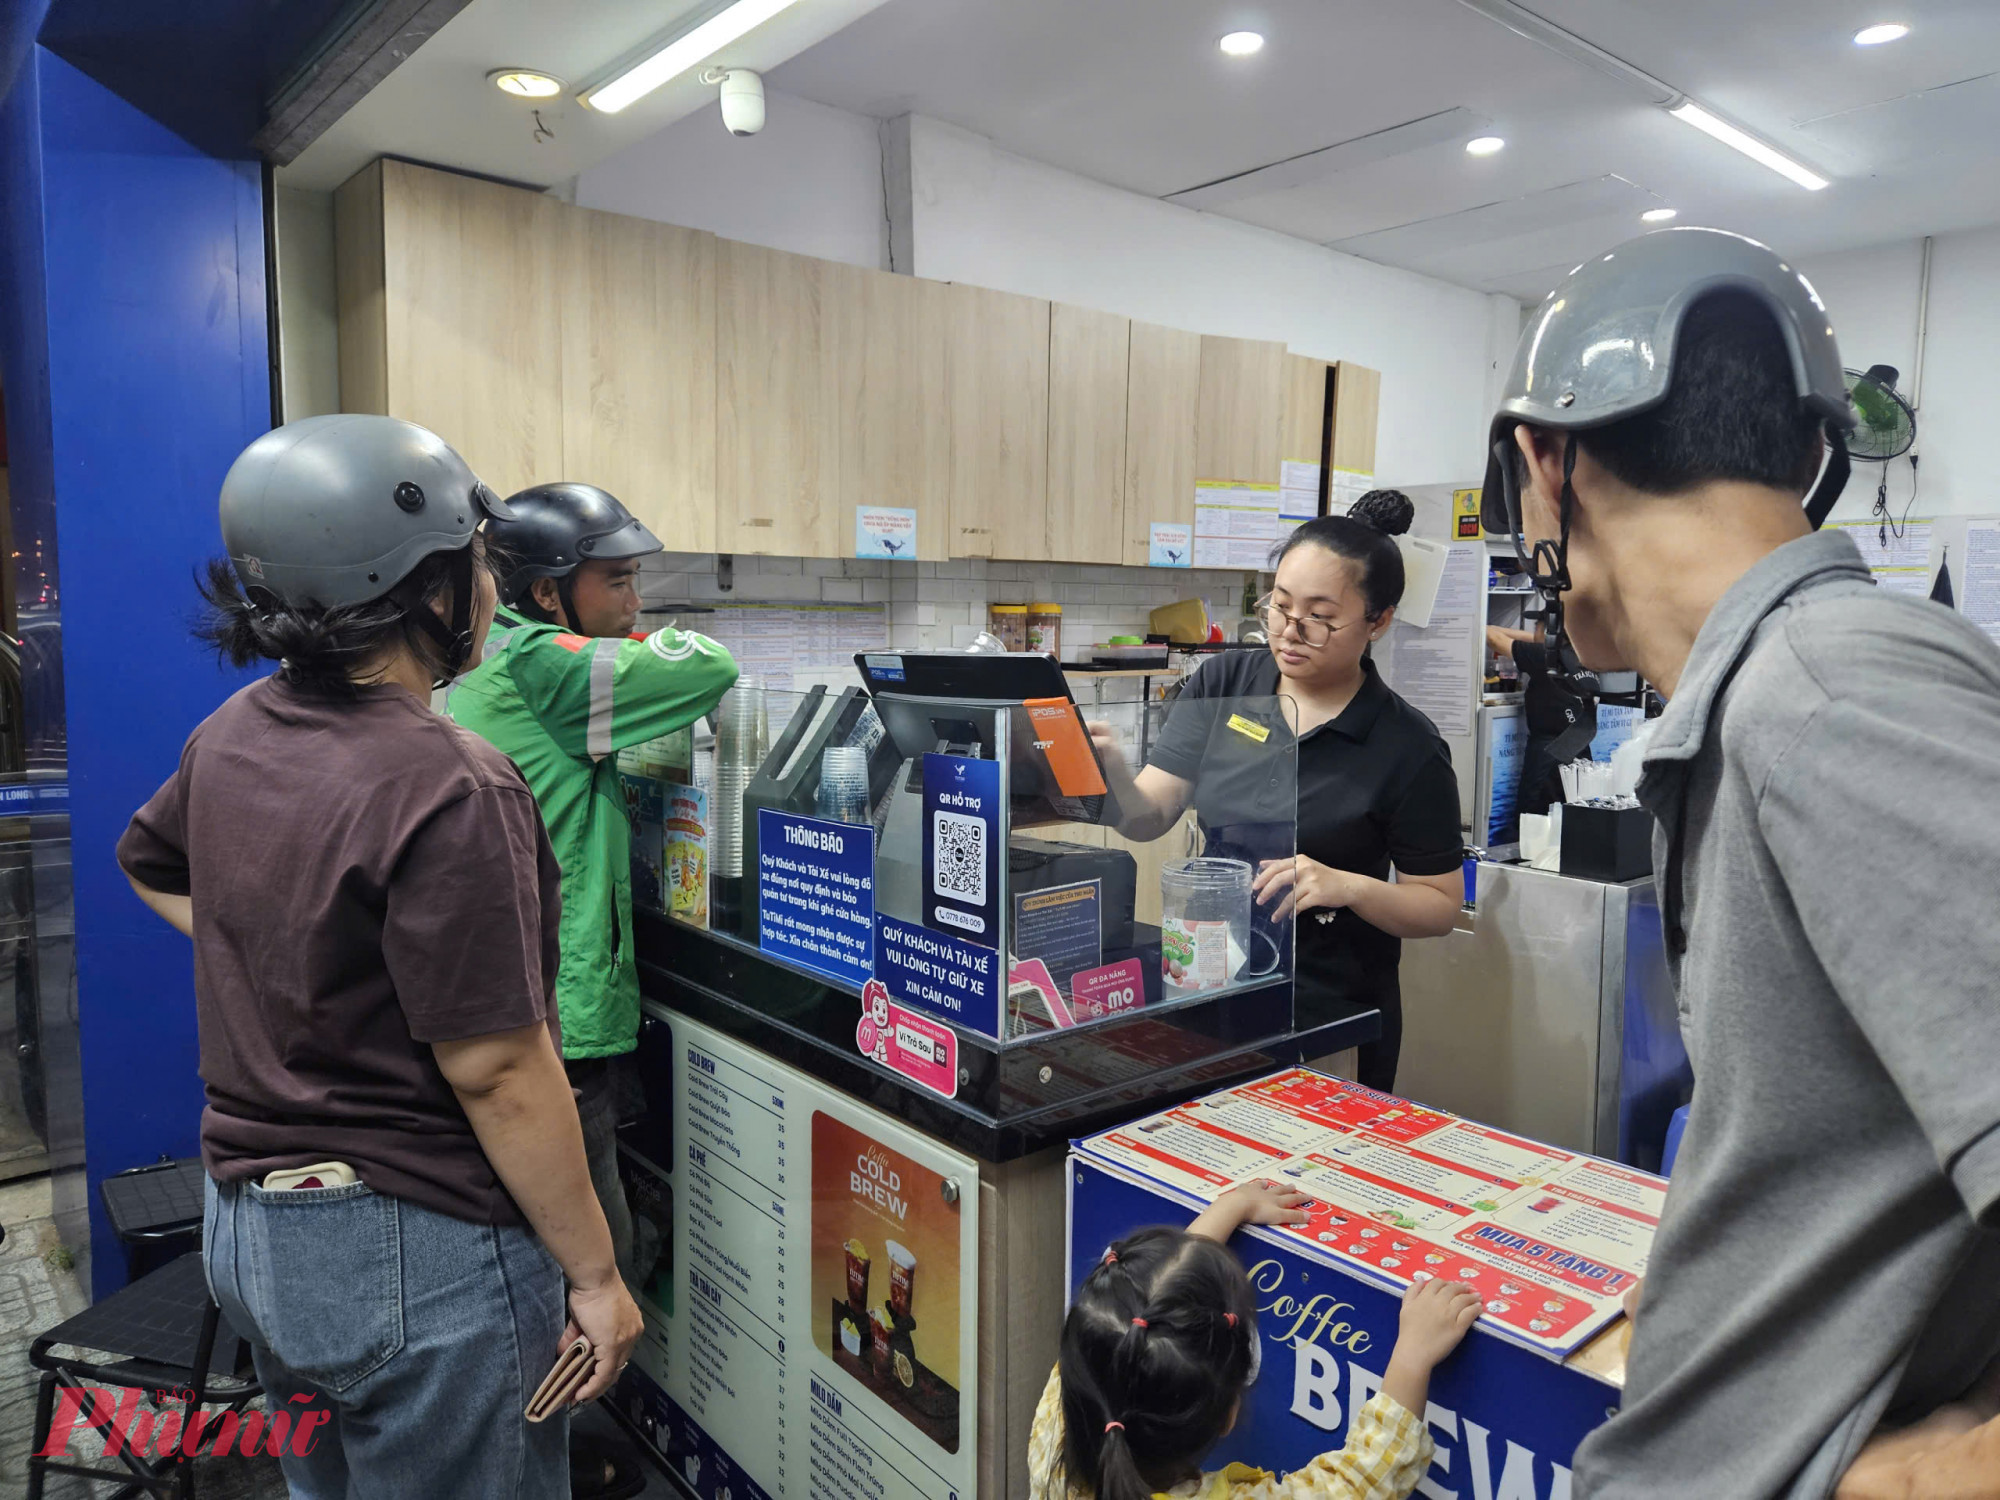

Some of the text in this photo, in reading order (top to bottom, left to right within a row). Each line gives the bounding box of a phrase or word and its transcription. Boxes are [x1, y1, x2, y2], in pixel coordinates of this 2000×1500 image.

[939, 791, 981, 812] QR HỖ TRỢ
[784, 825, 843, 853] THÔNG BÁO
[761, 853, 871, 889] Quý Khách và Tài Xế vui lòng đỗ
[762, 872, 856, 904] xe đúng nơi quy định và bảo
[762, 887, 872, 928] quản tư trang khi ghé cửa hàng.
[762, 909, 865, 952] TuTiMi rất mong nhận được sự
[762, 925, 872, 970] hợp tác. Xin chân thành cảm ơn!
[883, 926, 987, 974] QUÝ KHÁCH VÀ TÀI XẾ
[886, 948, 984, 995] VUI LÒNG TỰ GIỮ XE
[905, 980, 961, 1011] XIN CẢM ƠN!
[899, 1030, 930, 1054] Ví Trả Sau
[858, 1154, 900, 1191] COLD
[850, 1171, 907, 1220] BREW
[1475, 1226, 1625, 1285] MUA 5 TẶNG 1
[1246, 1259, 1373, 1354] Coffee
